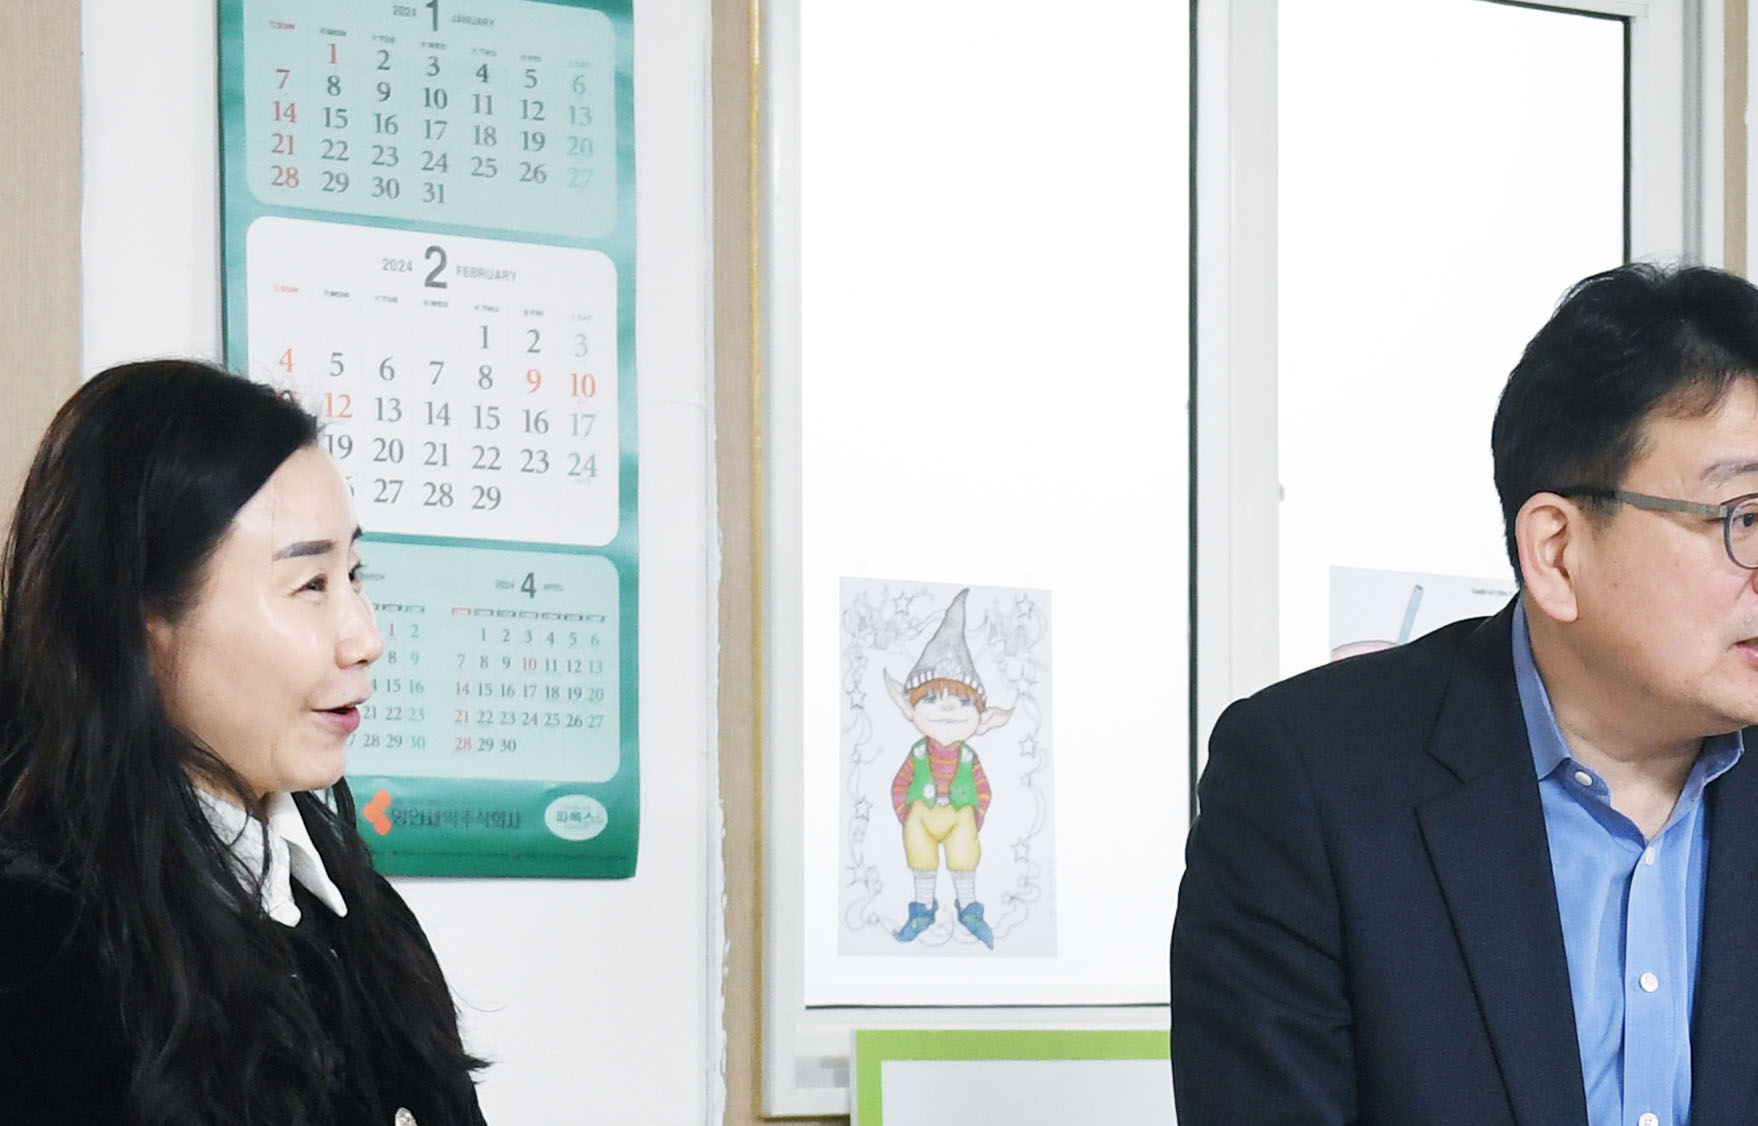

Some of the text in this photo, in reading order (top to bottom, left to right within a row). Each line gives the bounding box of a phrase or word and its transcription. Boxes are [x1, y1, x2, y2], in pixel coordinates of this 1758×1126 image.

[393, 0, 495, 31] 2024 1 JANUARY
[328, 43, 586, 95] 1 2 3 4 5 6
[276, 69, 592, 126] 7 8 9 10 11 12 13
[273, 101, 594, 156] 14 15 16 17 18 19 20
[272, 133, 595, 188] 21 22 23 24 25 26 27
[271, 165, 444, 204] 28 29 30 31
[382, 245, 517, 289] 2024 2 FEBRUARY
[479, 325, 588, 358] 1 2 3
[279, 348, 596, 397] 4 5 6 7 8 9 10
[325, 393, 596, 437] 12 13 14 15 16 17
[326, 434, 597, 477] 19 20 21 22 23 24
[374, 479, 501, 510] 27 28 29
[520, 572, 537, 599] 4
[388, 623, 419, 639] 1 2
[481, 627, 600, 647] 1 2 3 4 5 6
[388, 651, 420, 665] 8 9
[457, 653, 603, 674] 7 8 9 10 11 12 13
[387, 678, 401, 692] 15
[410, 680, 424, 694] 16
[456, 682, 604, 702] 14 15 16 17 18 19 20
[363, 706, 425, 722] 21 22 23
[455, 709, 604, 728] 21 22 23 24 25 26 27
[363, 734, 380, 747] 28
[387, 734, 402, 748] 29
[410, 736, 426, 749] 30
[456, 737, 516, 752] 28 29 30
